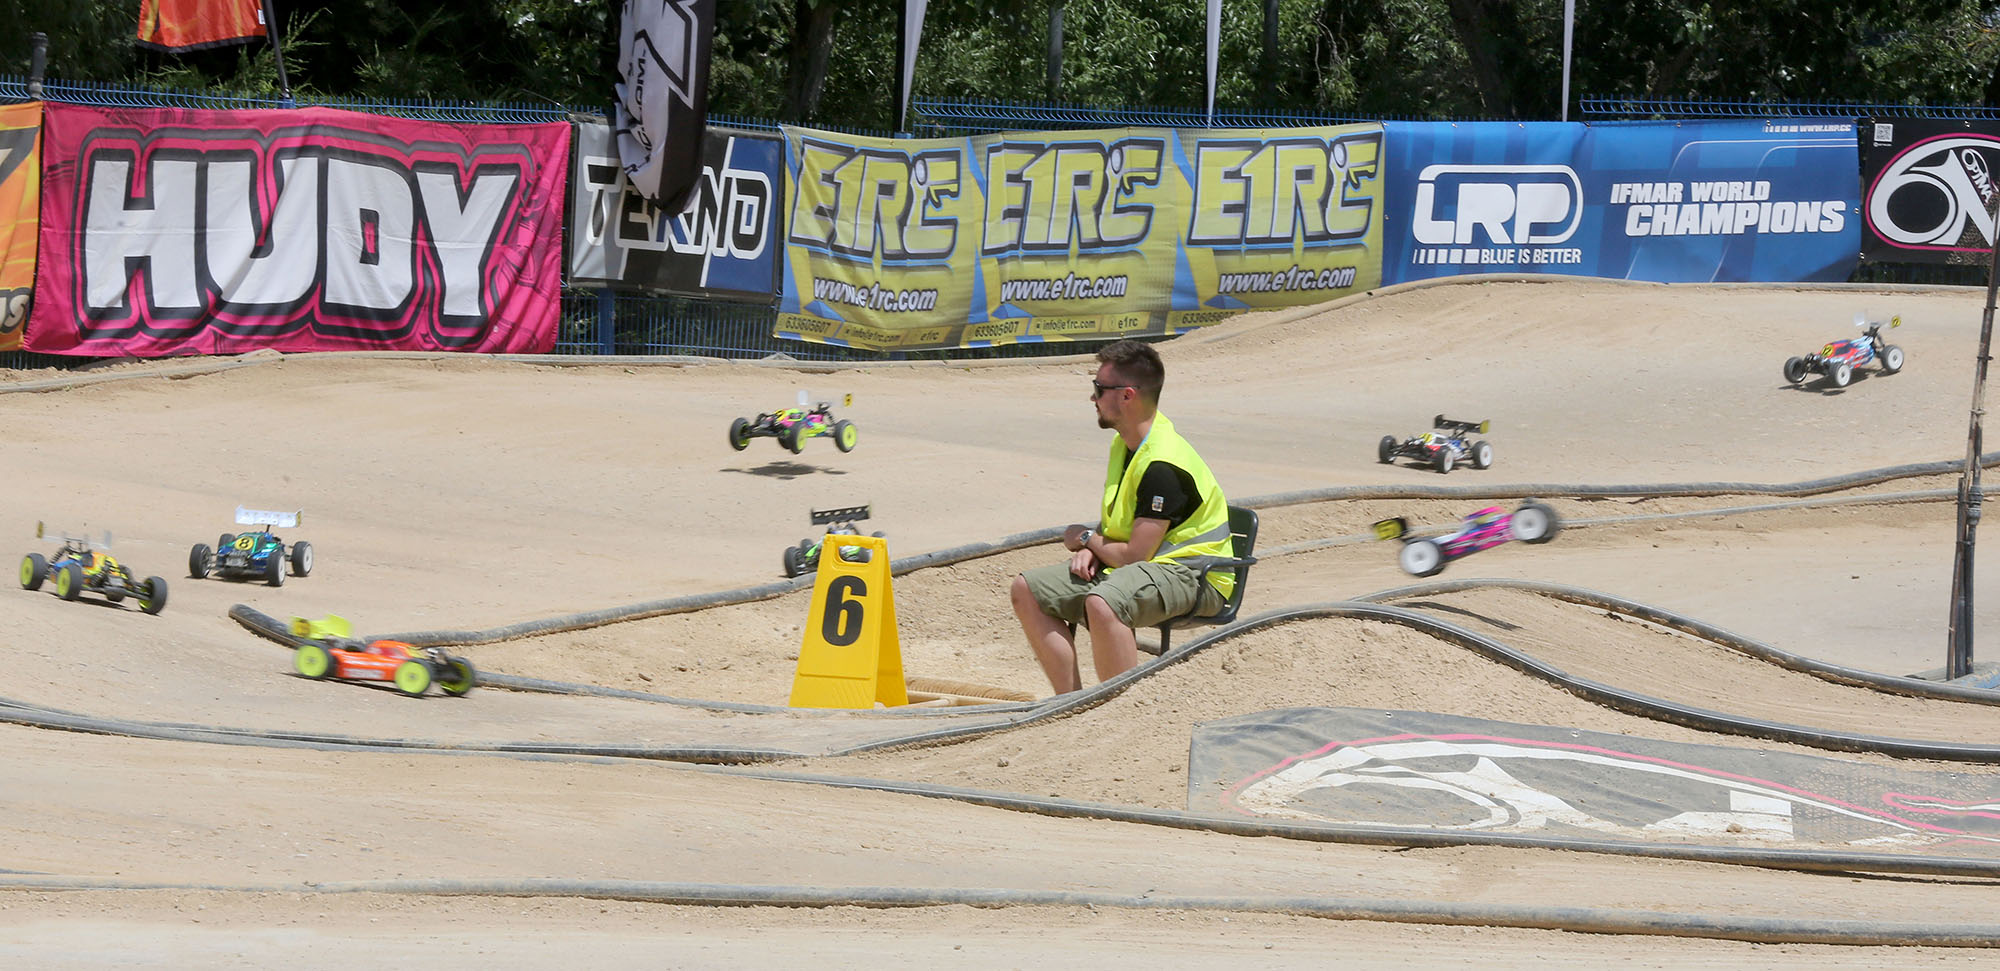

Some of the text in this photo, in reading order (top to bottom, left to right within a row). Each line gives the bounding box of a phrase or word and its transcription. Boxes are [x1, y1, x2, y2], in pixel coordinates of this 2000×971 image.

[1412, 165, 1583, 244] LRP
[1610, 181, 1771, 204] IFMAR WORLD
[1625, 200, 1847, 237] CHAMPIONS
[80, 148, 524, 324] HUDY
[1480, 248, 1582, 264] BLUE IS BETTER
[812, 277, 938, 312] www.e1rc.com
[1000, 271, 1128, 303] www.e1rc.com
[1218, 264, 1356, 294] www.e1rc.com
[974, 316, 1138, 337] 633605607 info@e1rc.com e1rc
[238, 538, 250, 549] 8
[821, 575, 868, 646] 6
